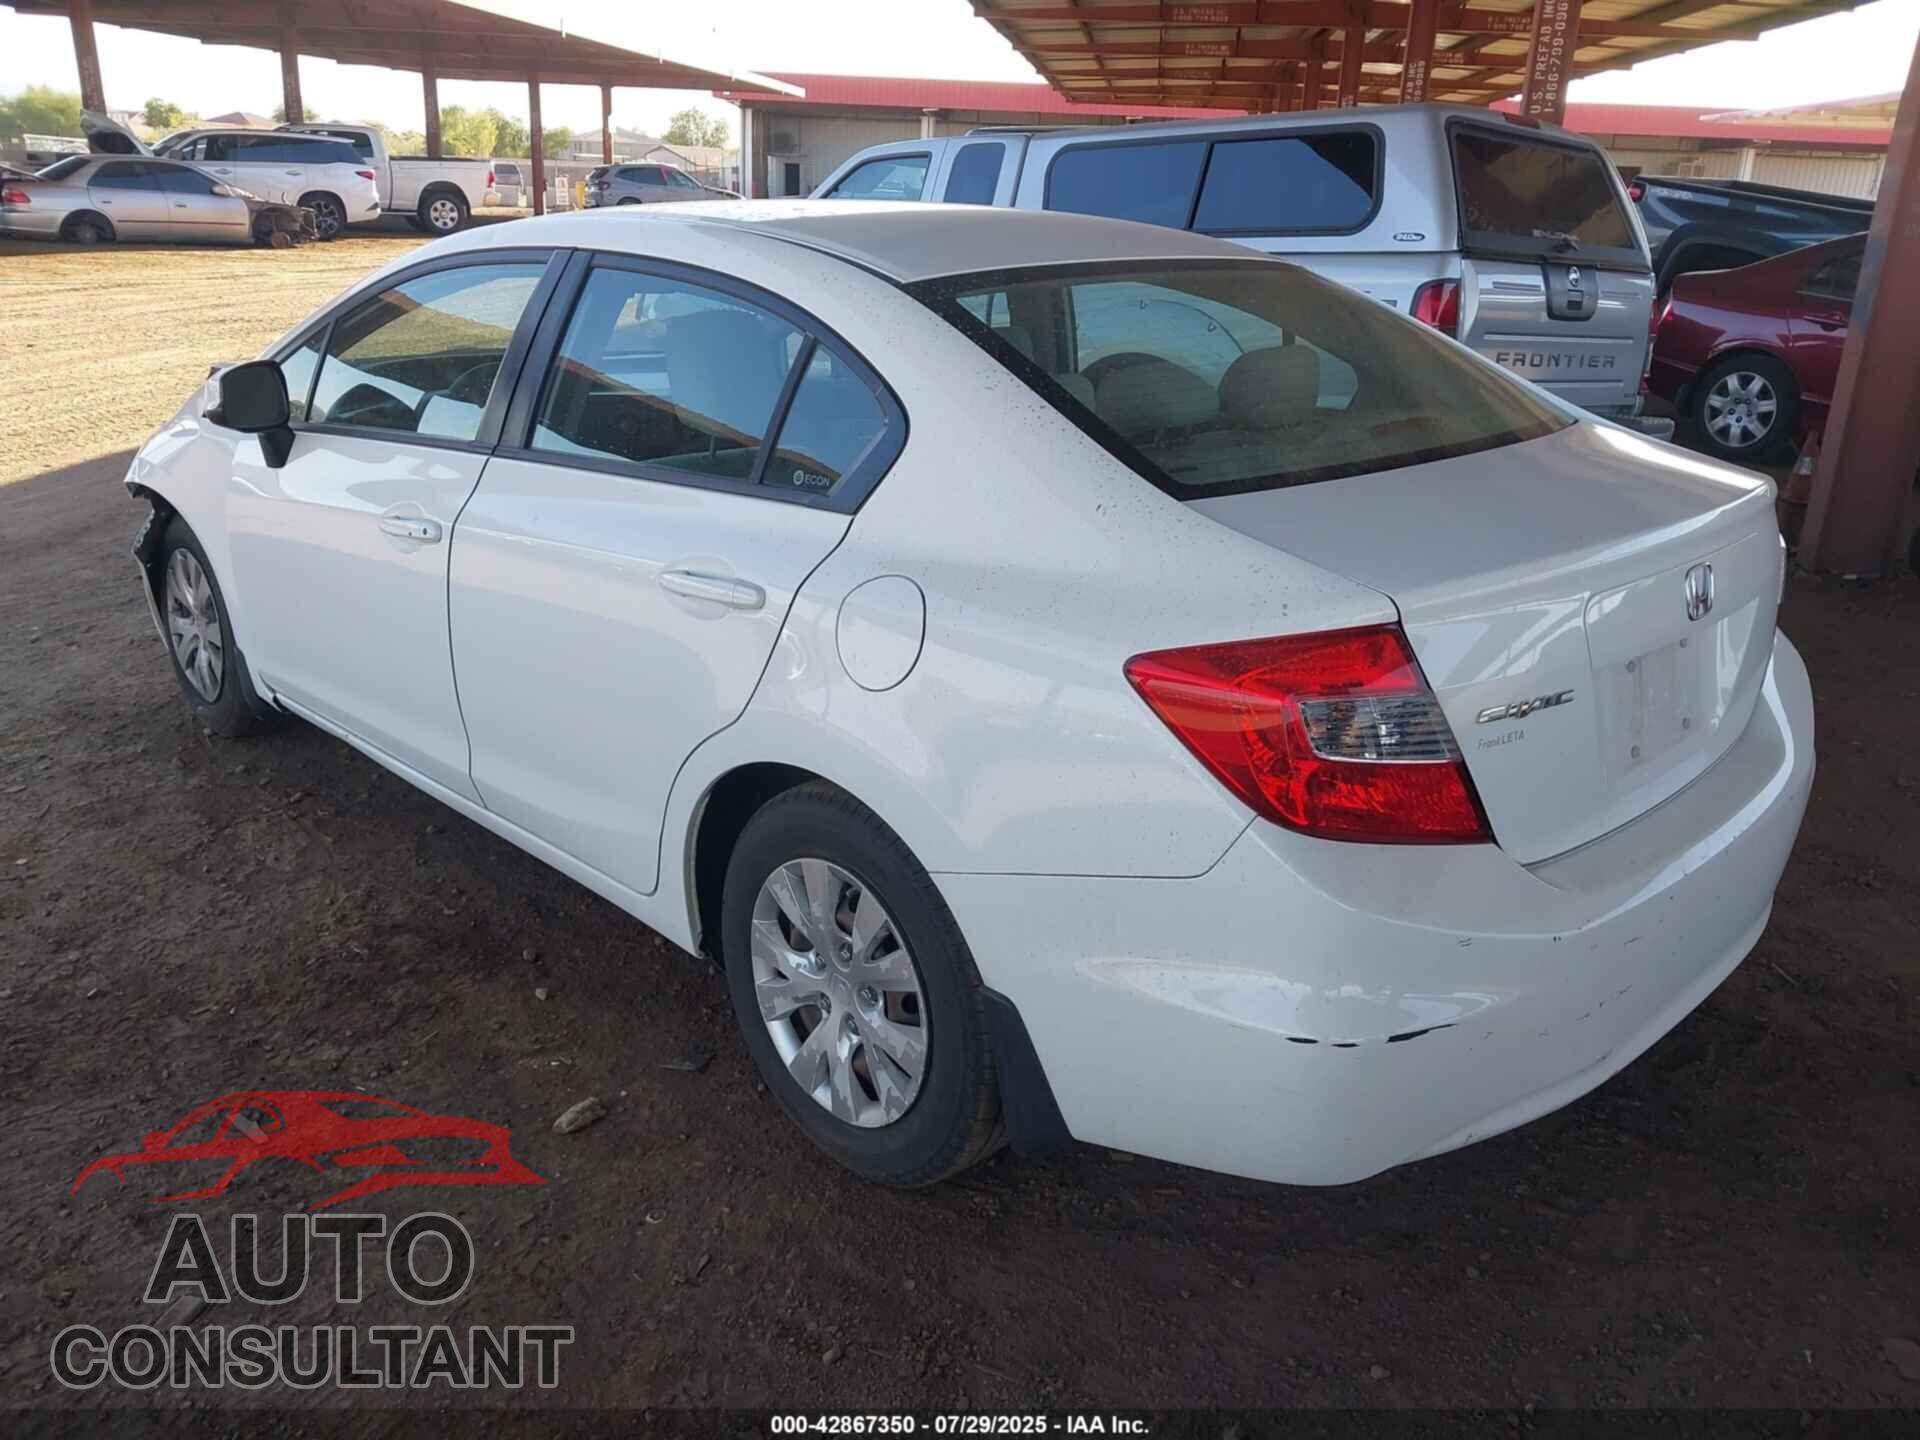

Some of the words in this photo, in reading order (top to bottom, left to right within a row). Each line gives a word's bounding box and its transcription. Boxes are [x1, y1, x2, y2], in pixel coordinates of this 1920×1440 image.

[1535, 25, 1552, 80] PREFAB
[1543, 0, 1568, 112] 1-866-799-096
[1495, 351, 1616, 368] FRONTIER
